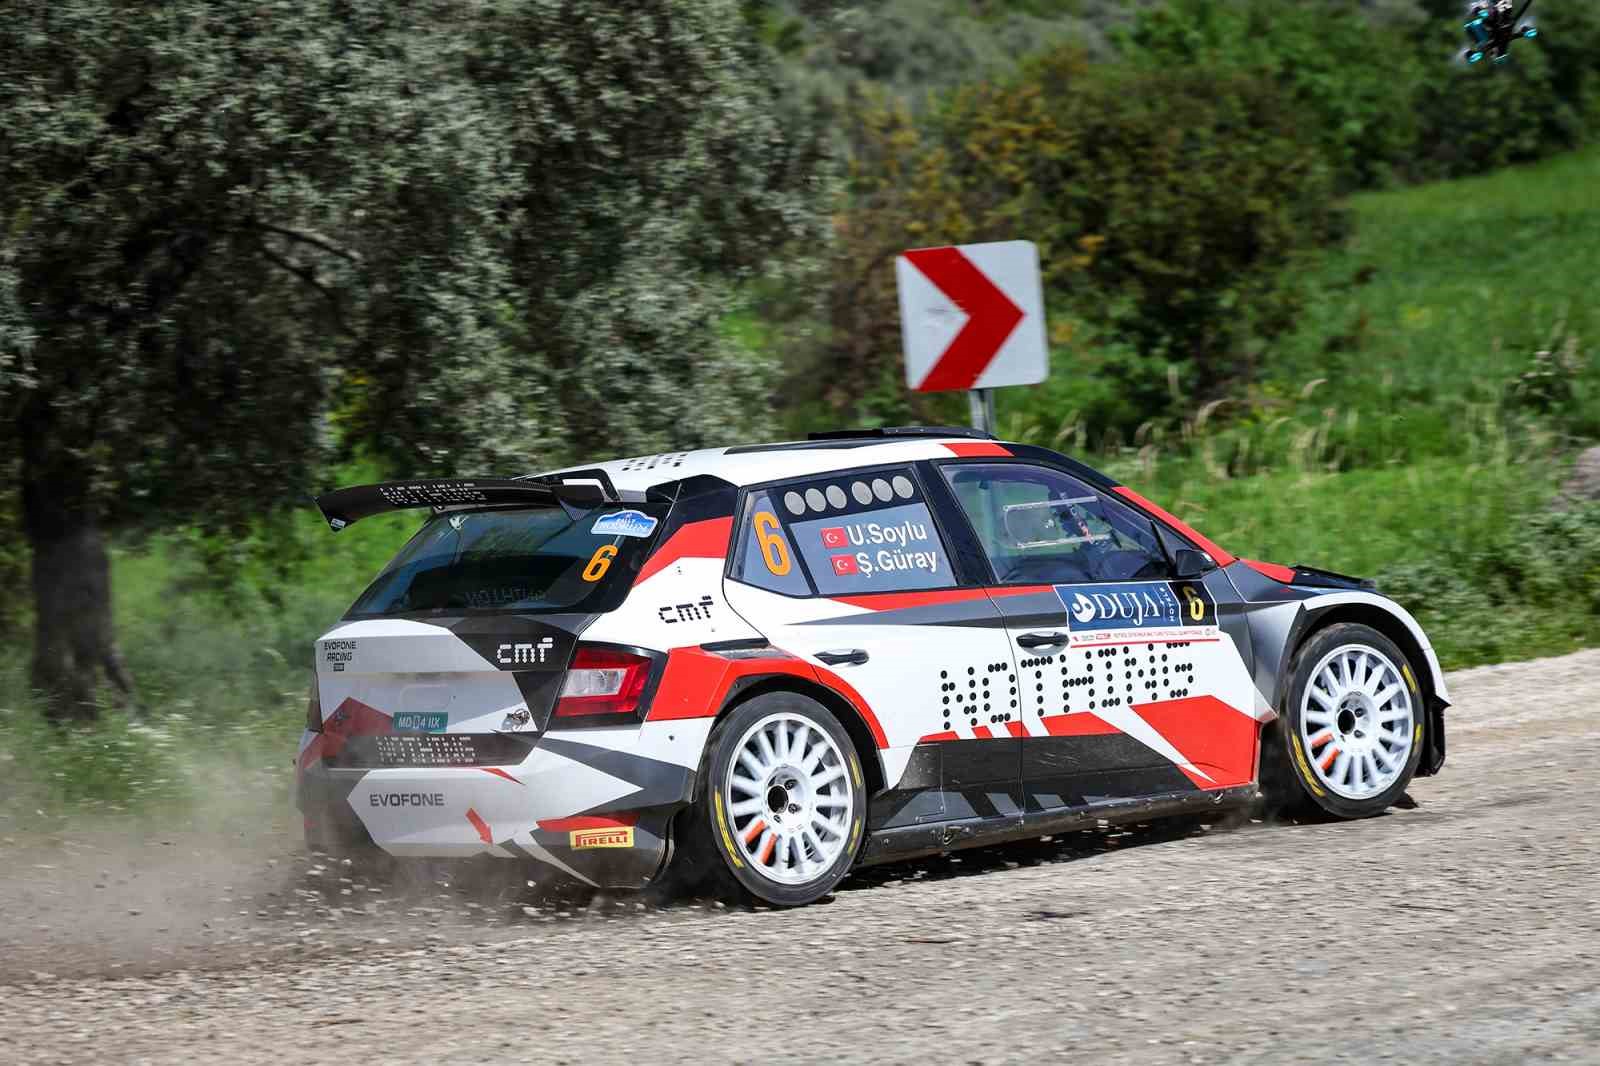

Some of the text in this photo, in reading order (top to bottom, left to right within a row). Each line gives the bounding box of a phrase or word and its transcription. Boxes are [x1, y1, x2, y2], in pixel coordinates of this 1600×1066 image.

[754, 511, 792, 576] 6
[848, 521, 928, 547] U.Soylu
[582, 545, 618, 582] 6
[856, 550, 938, 578] Ş.Güray
[658, 595, 714, 624] cmf
[1091, 592, 1161, 626] DUJA
[1183, 586, 1205, 621] 6
[324, 641, 358, 650] EVOFONE
[327, 652, 353, 661] RACING
[497, 637, 553, 664] cmf
[939, 642, 1196, 731] NOTHING
[375, 736, 475, 763] NOTHING
[369, 793, 445, 807] EVOFONE
[575, 831, 628, 848] PIRELLI
